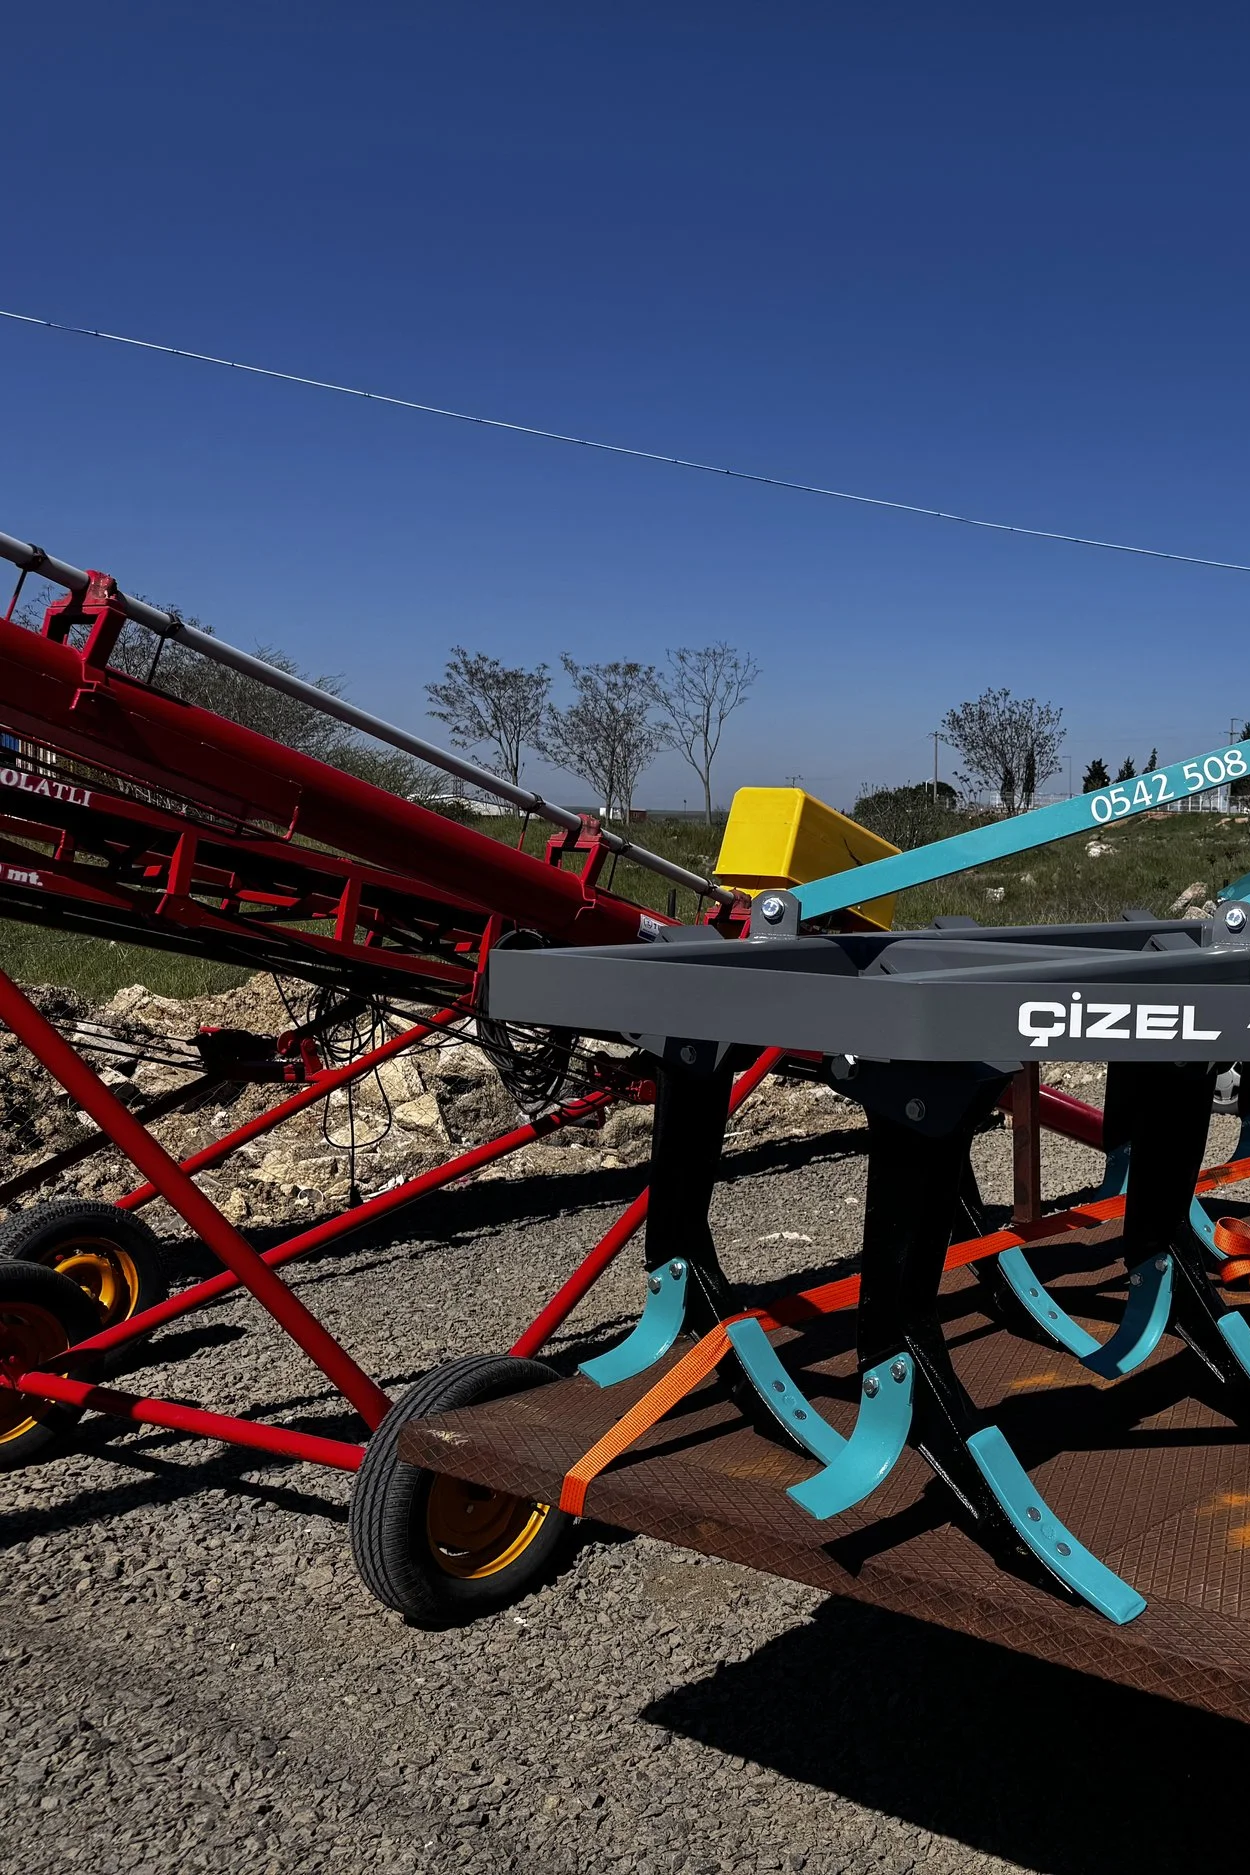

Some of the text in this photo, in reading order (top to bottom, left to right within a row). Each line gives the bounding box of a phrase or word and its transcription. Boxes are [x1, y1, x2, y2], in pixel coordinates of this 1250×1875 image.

[0, 768, 92, 807] OLATLI
[1090, 774, 1174, 823] 0542
[1183, 749, 1247, 792] 508
[8, 869, 43, 887] mt.
[1018, 991, 1222, 1047] ÇİZEL
